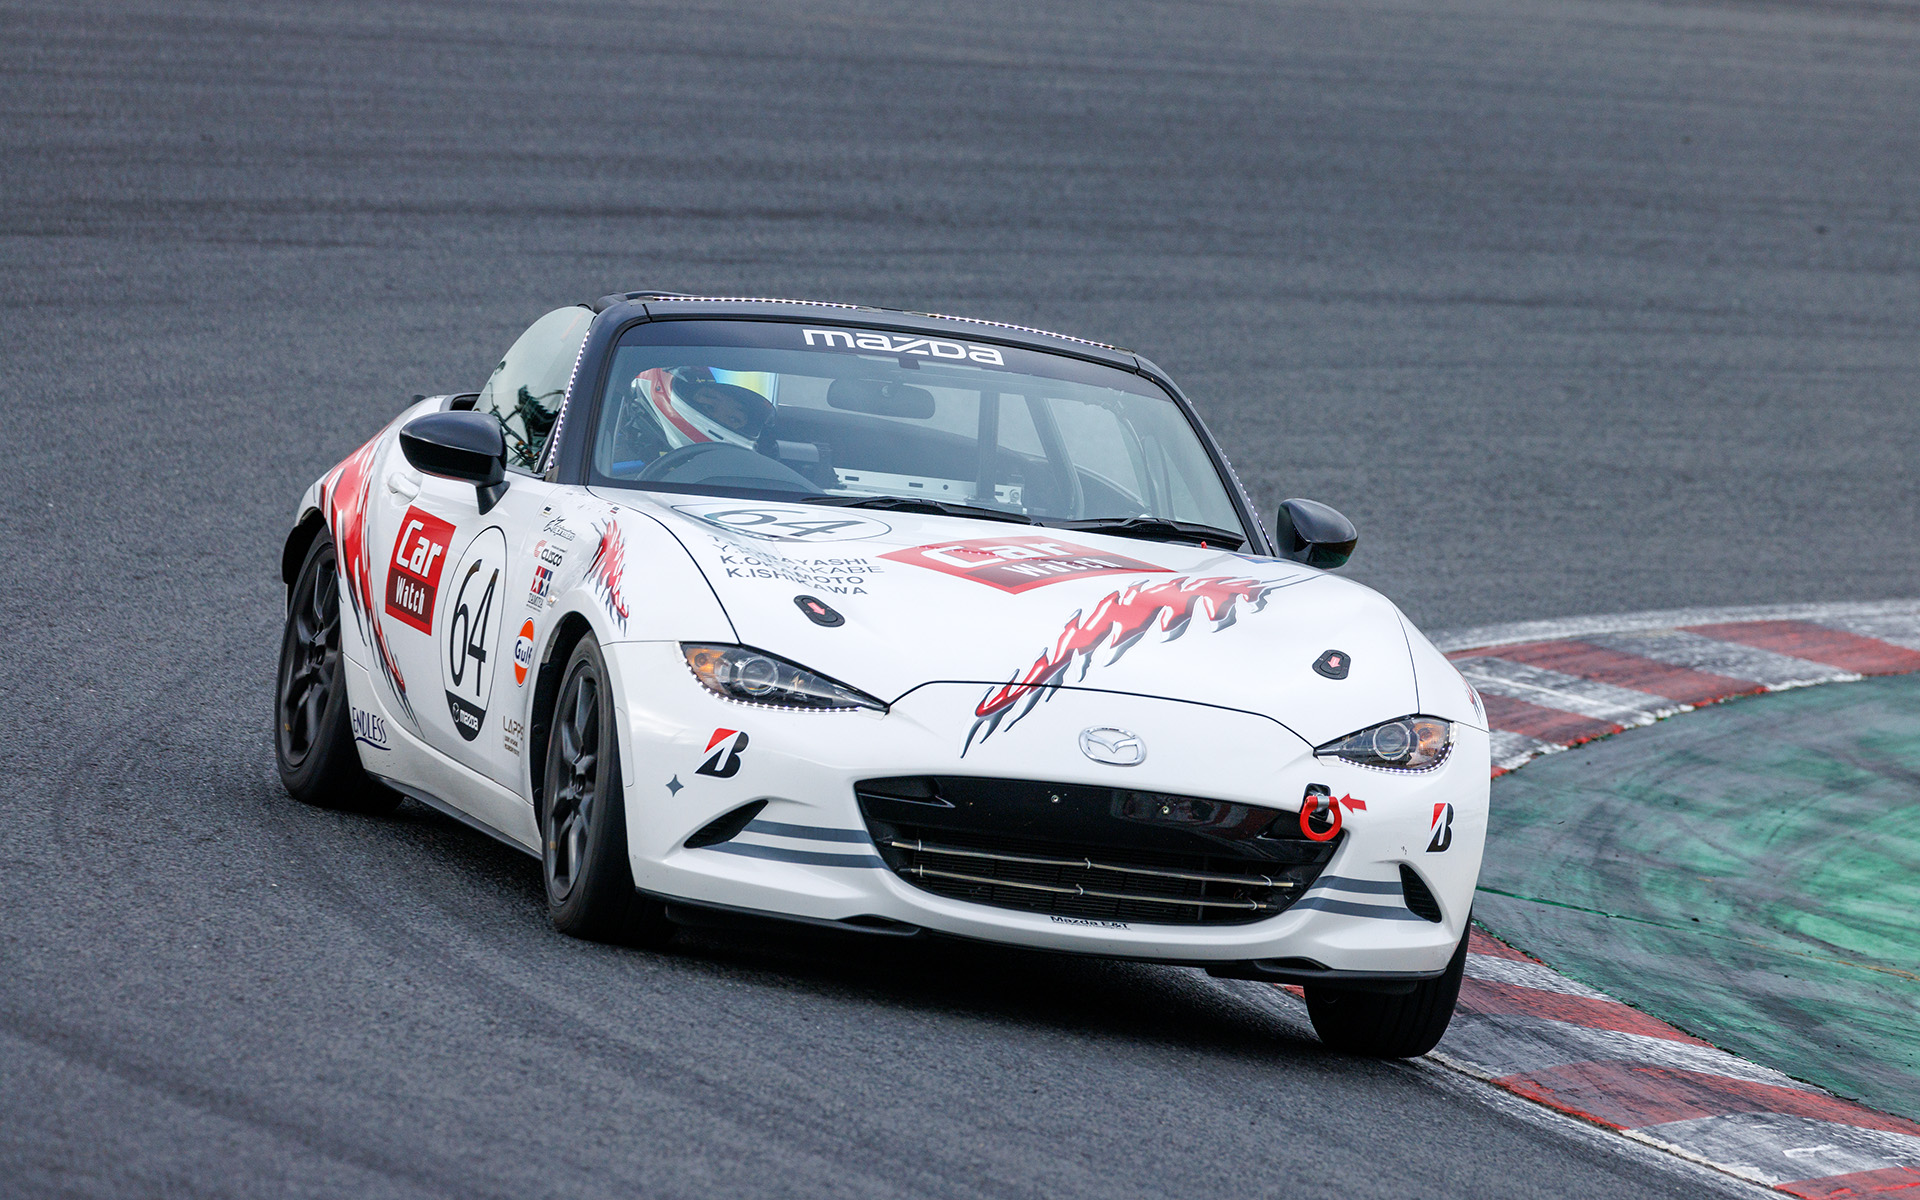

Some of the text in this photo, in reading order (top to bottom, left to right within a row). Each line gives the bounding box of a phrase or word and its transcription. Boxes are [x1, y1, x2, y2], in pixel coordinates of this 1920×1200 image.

[704, 508, 868, 537] 64
[396, 518, 443, 579] Car
[920, 541, 1074, 569] Car
[1001, 558, 1124, 578] Watch
[395, 575, 426, 616] Watch
[450, 559, 500, 697] 64
[515, 636, 532, 668] Gulf
[352, 706, 388, 744] ENDLESS
[1050, 915, 1098, 927] Mazda
